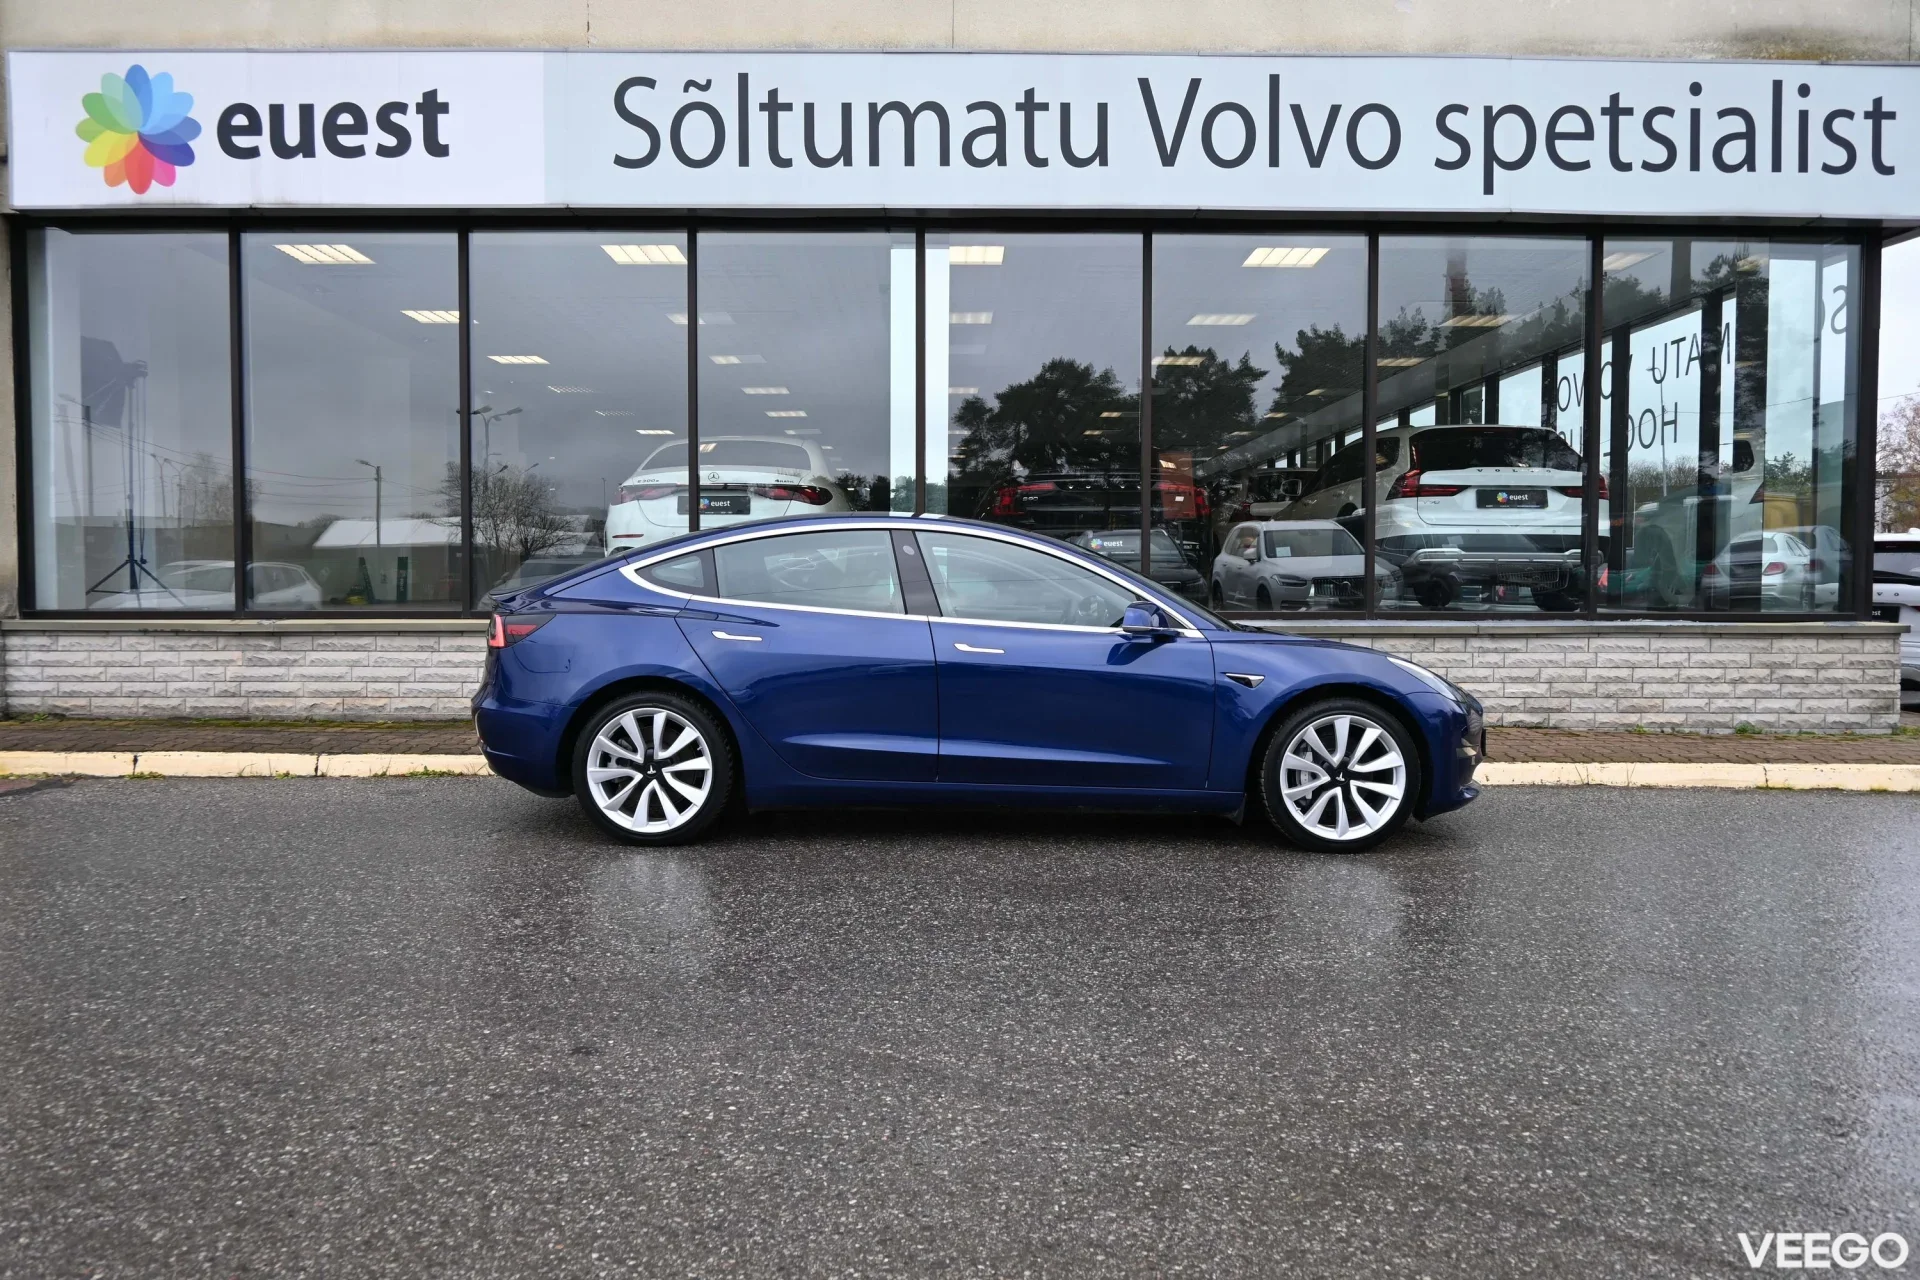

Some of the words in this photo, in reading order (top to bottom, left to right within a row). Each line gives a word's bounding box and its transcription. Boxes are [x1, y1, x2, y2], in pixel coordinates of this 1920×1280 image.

[217, 88, 450, 159] euest
[614, 73, 1108, 170] Sõltumatu
[1138, 74, 1402, 171] Volvo
[1435, 80, 1897, 195] spetsialist
[1510, 493, 1529, 501] euest
